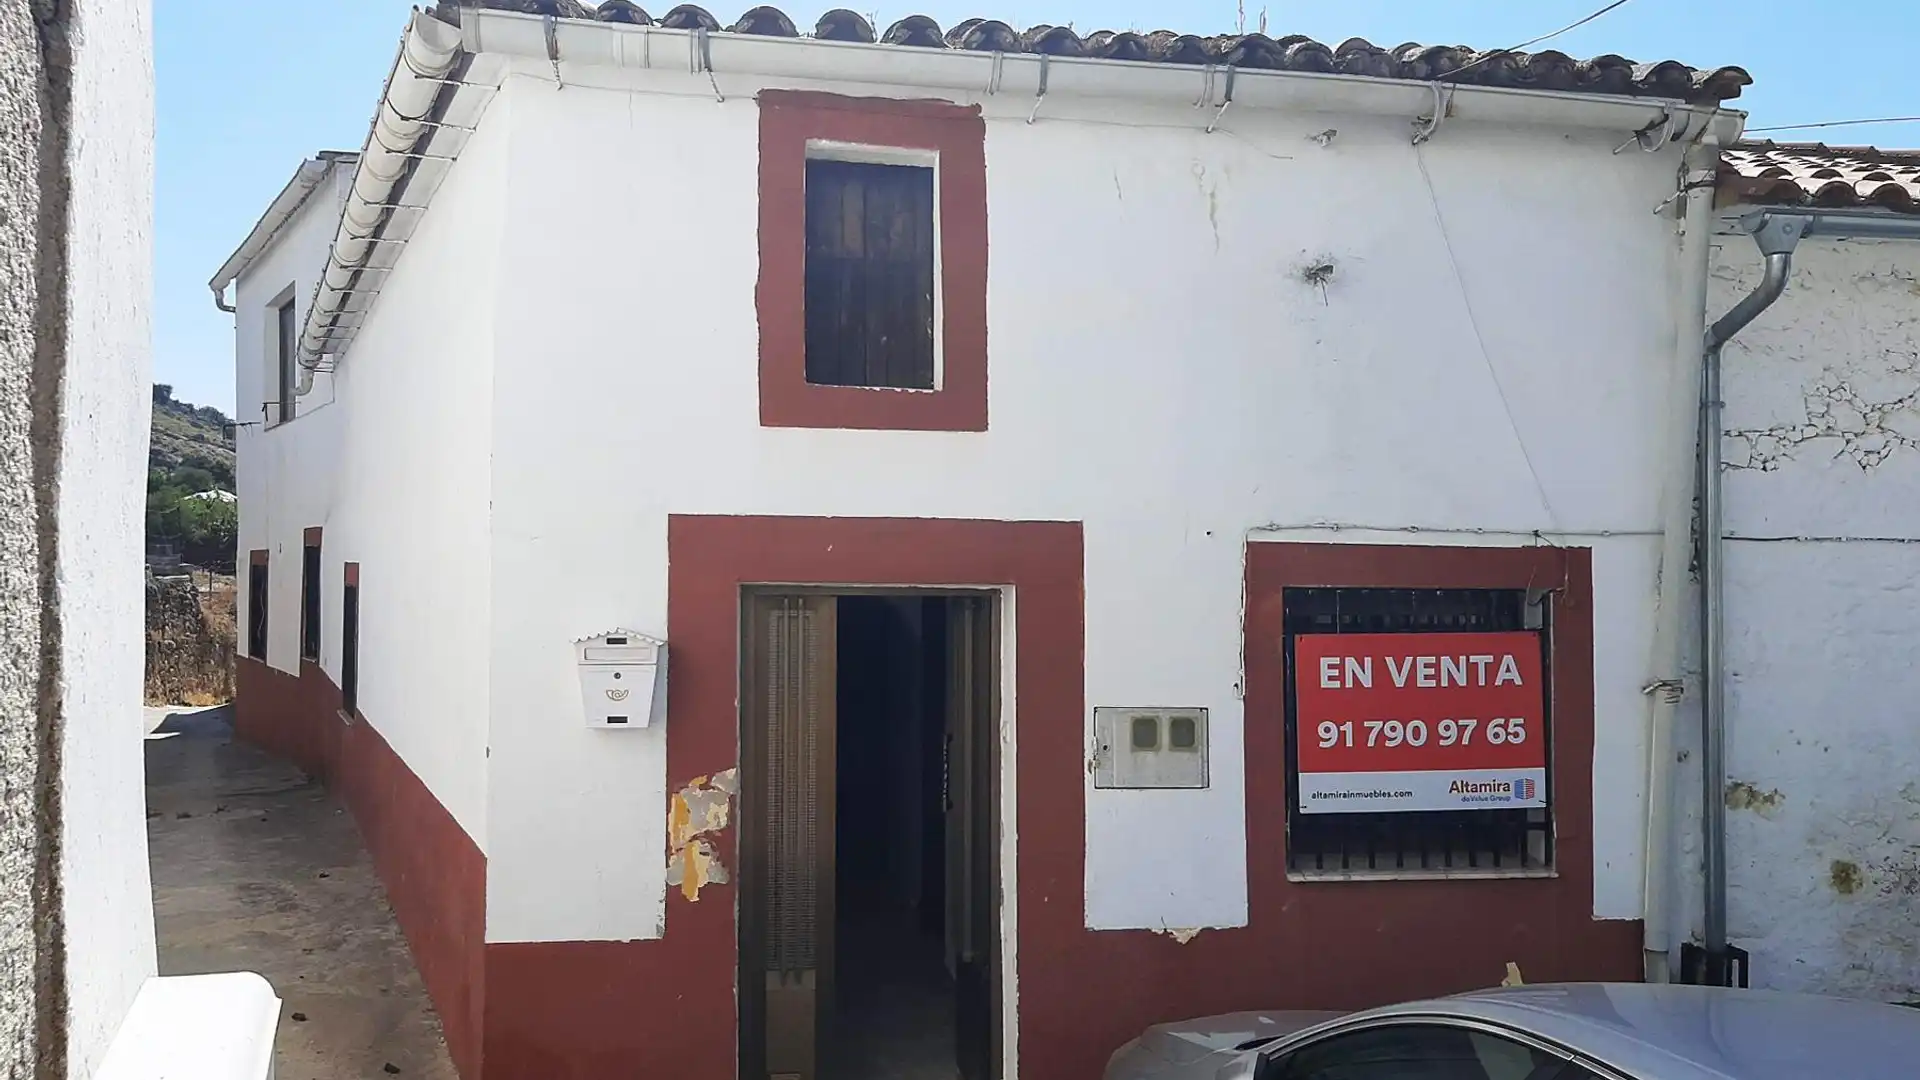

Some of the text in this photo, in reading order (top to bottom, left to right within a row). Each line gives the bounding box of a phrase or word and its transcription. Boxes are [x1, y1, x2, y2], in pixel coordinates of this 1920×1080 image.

[1319, 654, 1523, 689] EN VENTA
[1317, 717, 1526, 748] 91 790 97 65
[1311, 788, 1413, 800] altamirainmuebles.com
[1448, 778, 1511, 794] Altamira
[1490, 795, 1511, 803] Group
